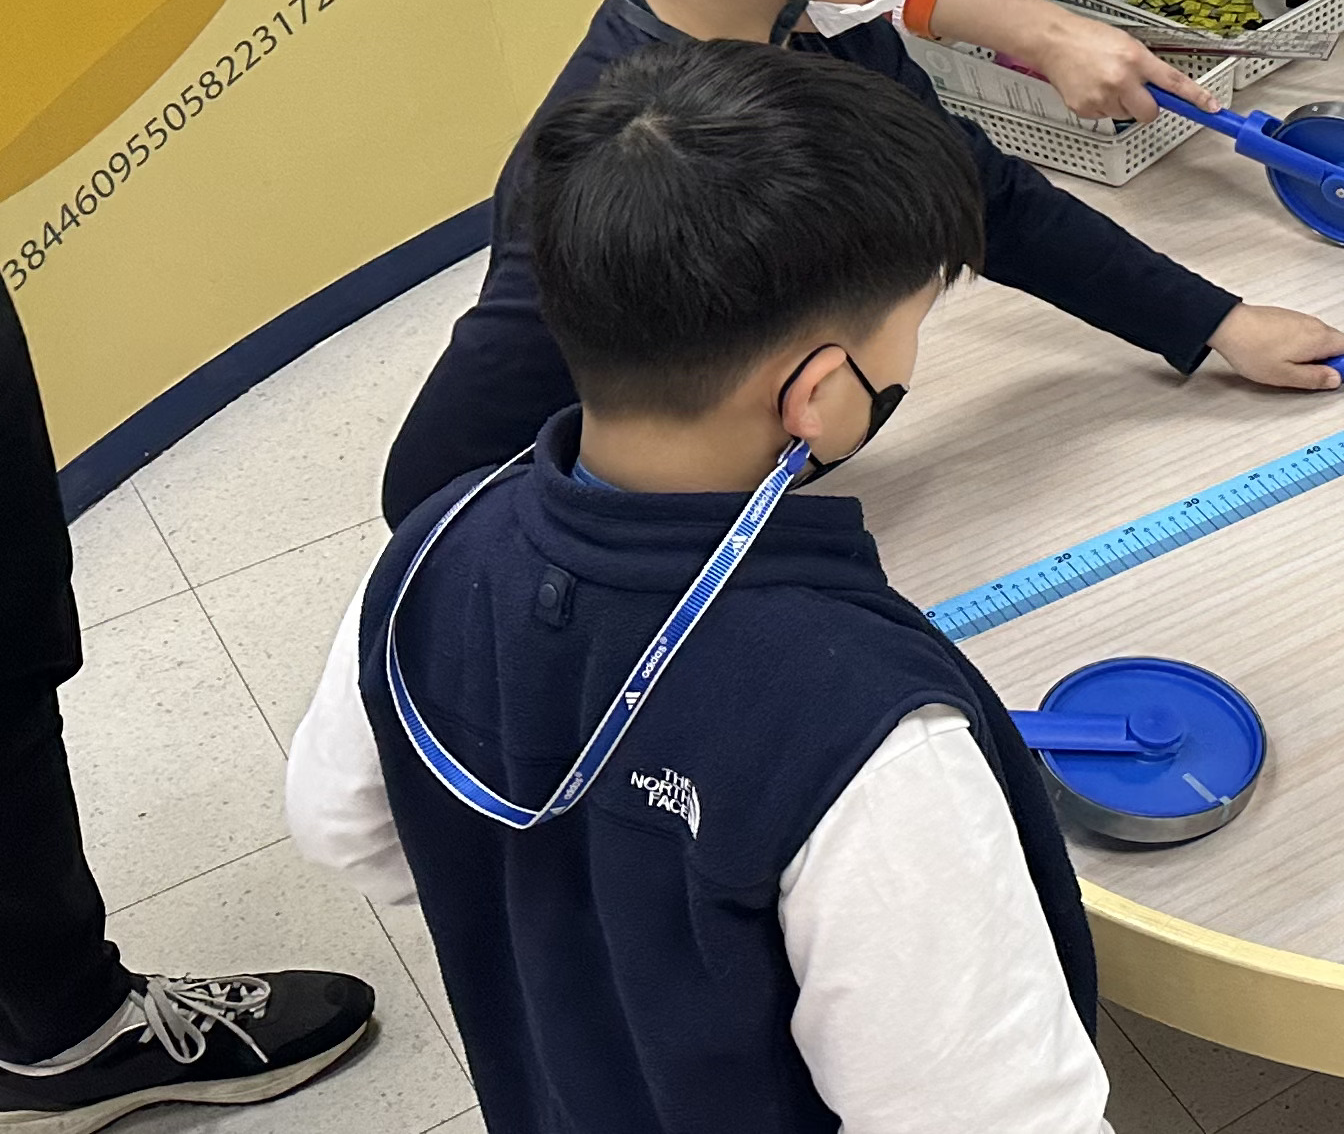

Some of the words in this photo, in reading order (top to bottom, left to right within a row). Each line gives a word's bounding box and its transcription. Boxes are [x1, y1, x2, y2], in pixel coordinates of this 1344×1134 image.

[1054, 553, 1072, 564] 20
[1183, 498, 1200, 508] 30
[1306, 445, 1321, 455] 40
[630, 771, 691, 806] NORTH
[662, 767, 692, 794] THE
[648, 791, 689, 821] FACE
